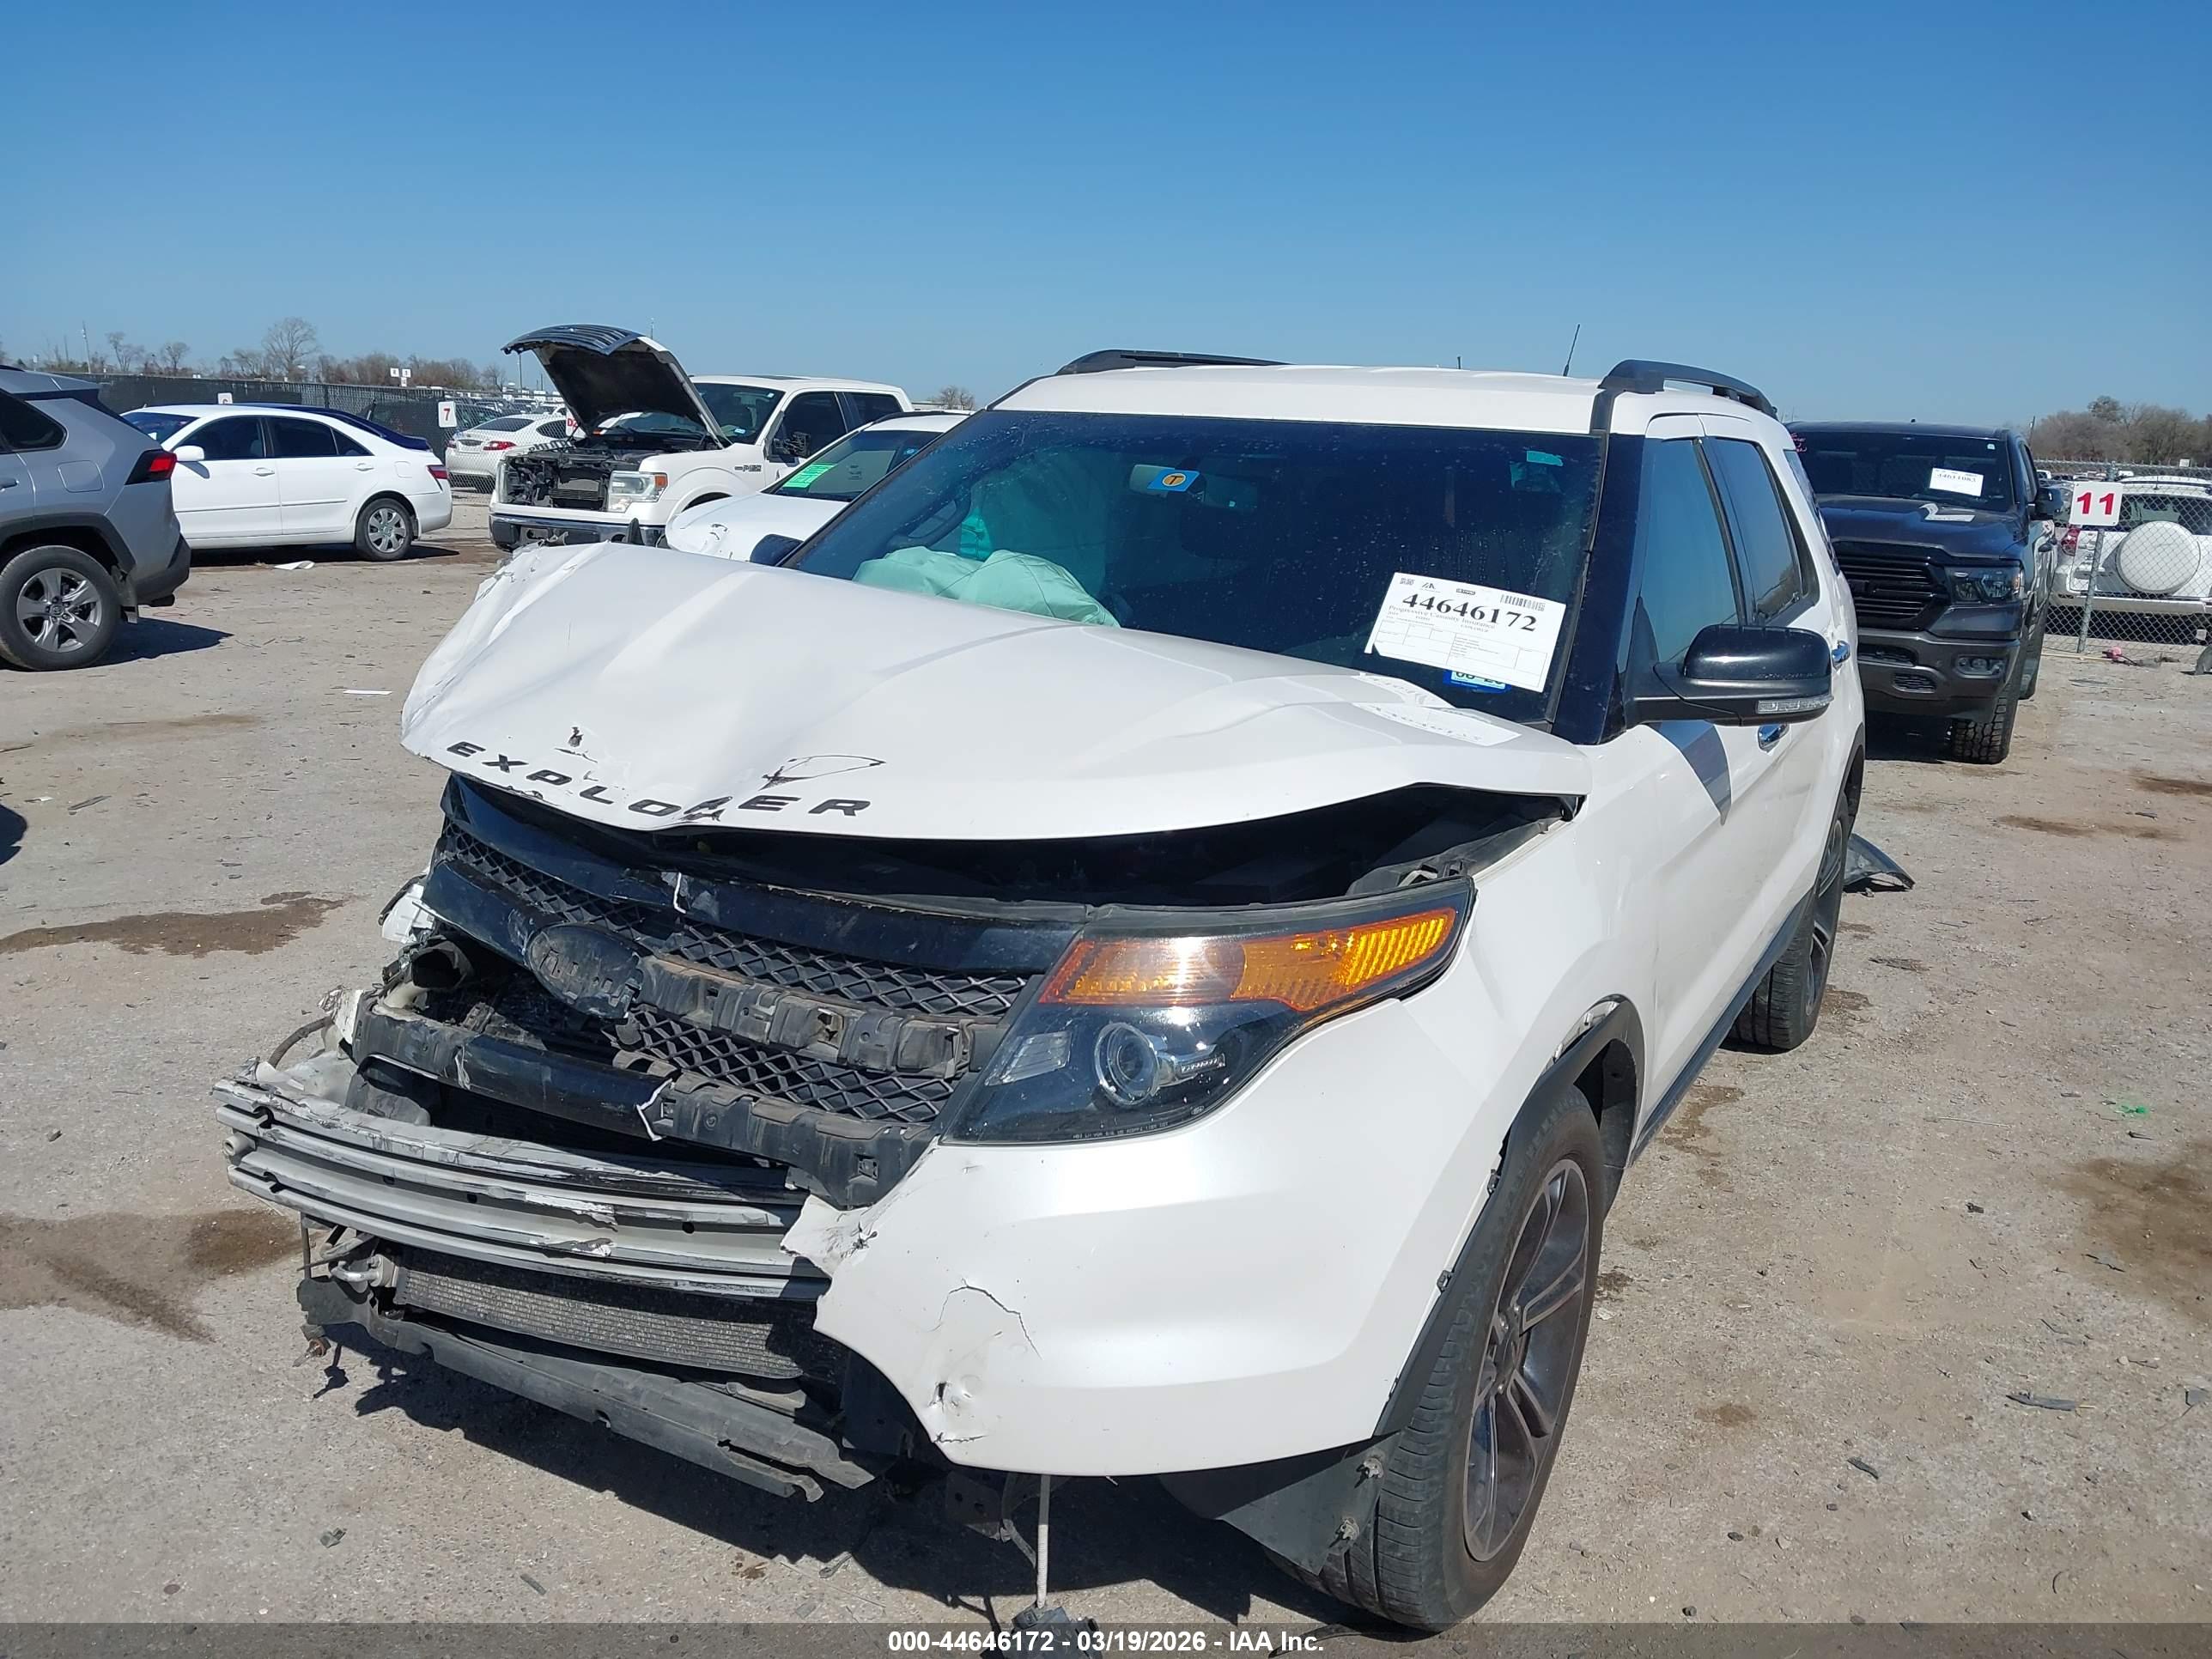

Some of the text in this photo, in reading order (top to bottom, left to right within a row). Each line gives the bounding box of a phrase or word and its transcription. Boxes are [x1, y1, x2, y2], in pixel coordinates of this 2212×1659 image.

[443, 408, 451, 422] 7
[2076, 491, 2115, 515] 11
[1402, 592, 1538, 632] 44646172
